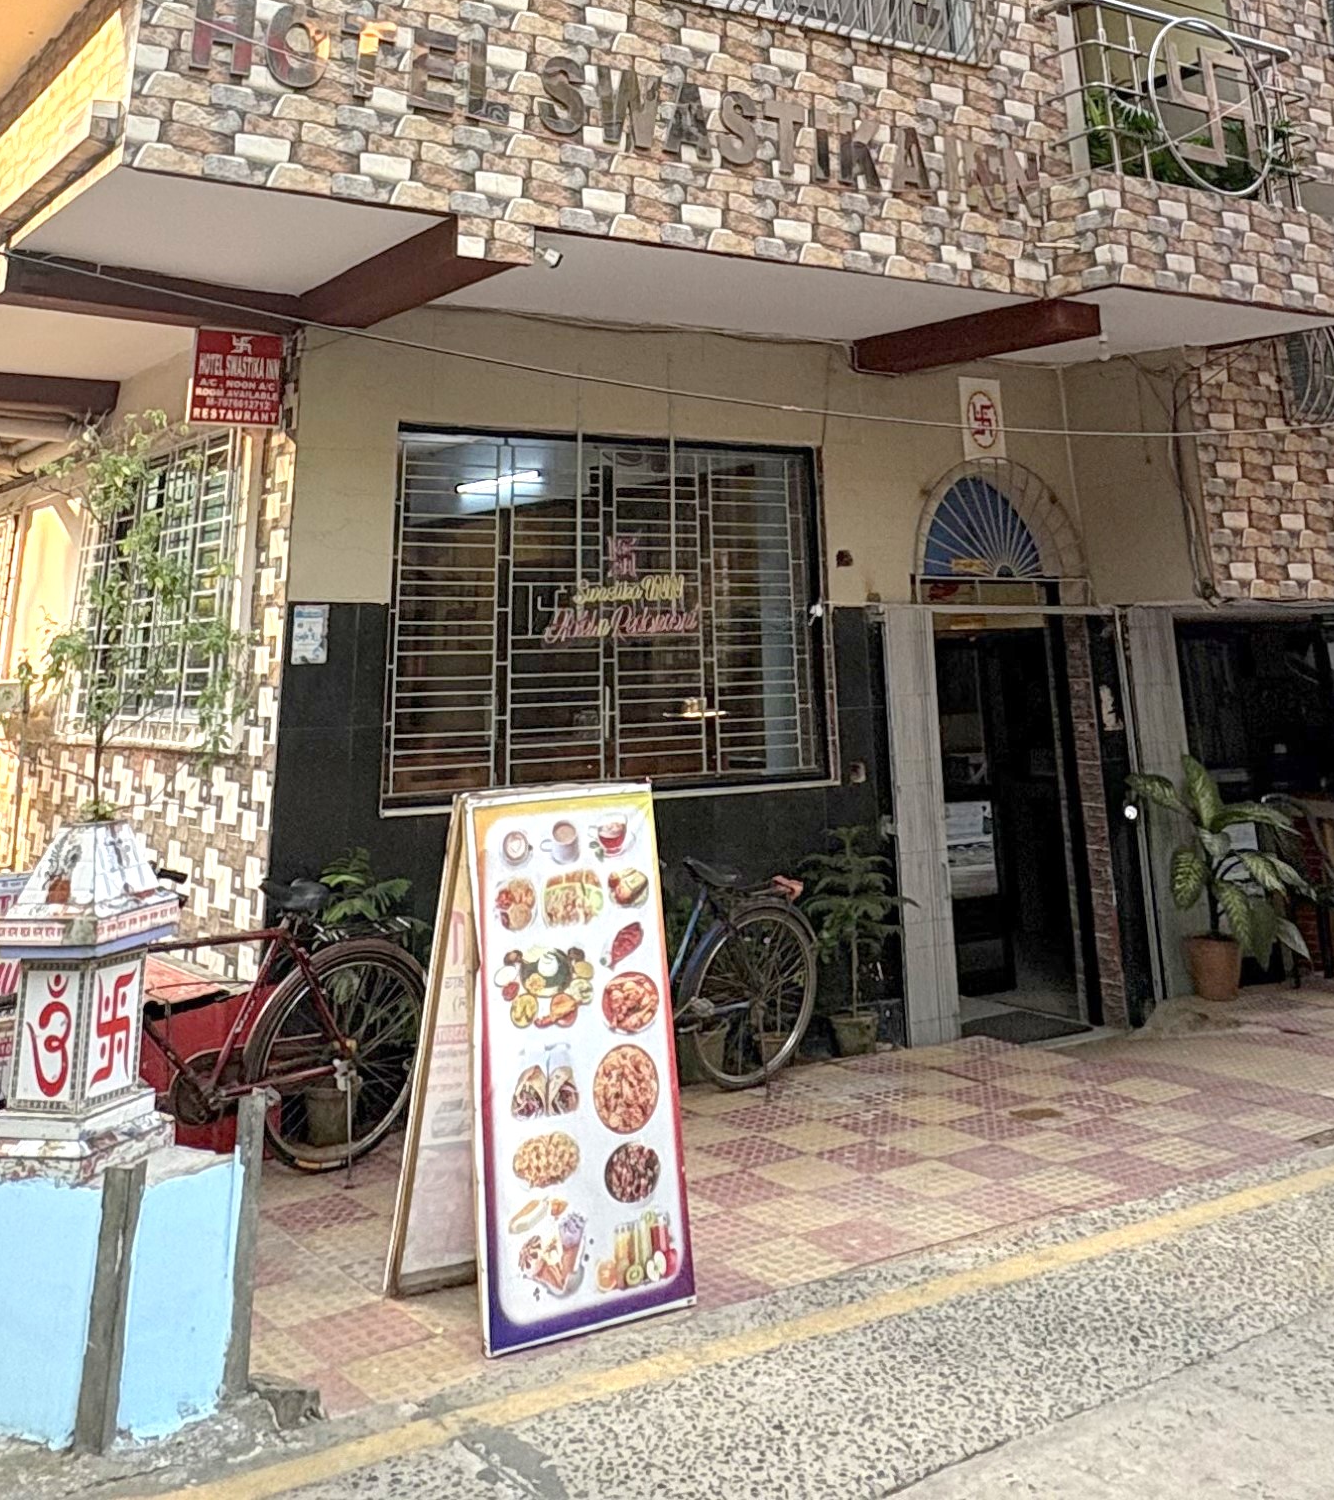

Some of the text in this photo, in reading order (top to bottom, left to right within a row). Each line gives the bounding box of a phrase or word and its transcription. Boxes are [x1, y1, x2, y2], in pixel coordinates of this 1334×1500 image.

[539, 56, 931, 196] SWASTIKA
[942, 130, 1046, 225] INN
[198, 352, 224, 376] HOTEL
[225, 354, 265, 379] SWASTIKA
[195, 387, 279, 401] ROOM AVAILABLE
[192, 408, 278, 422] RESTAURANT
